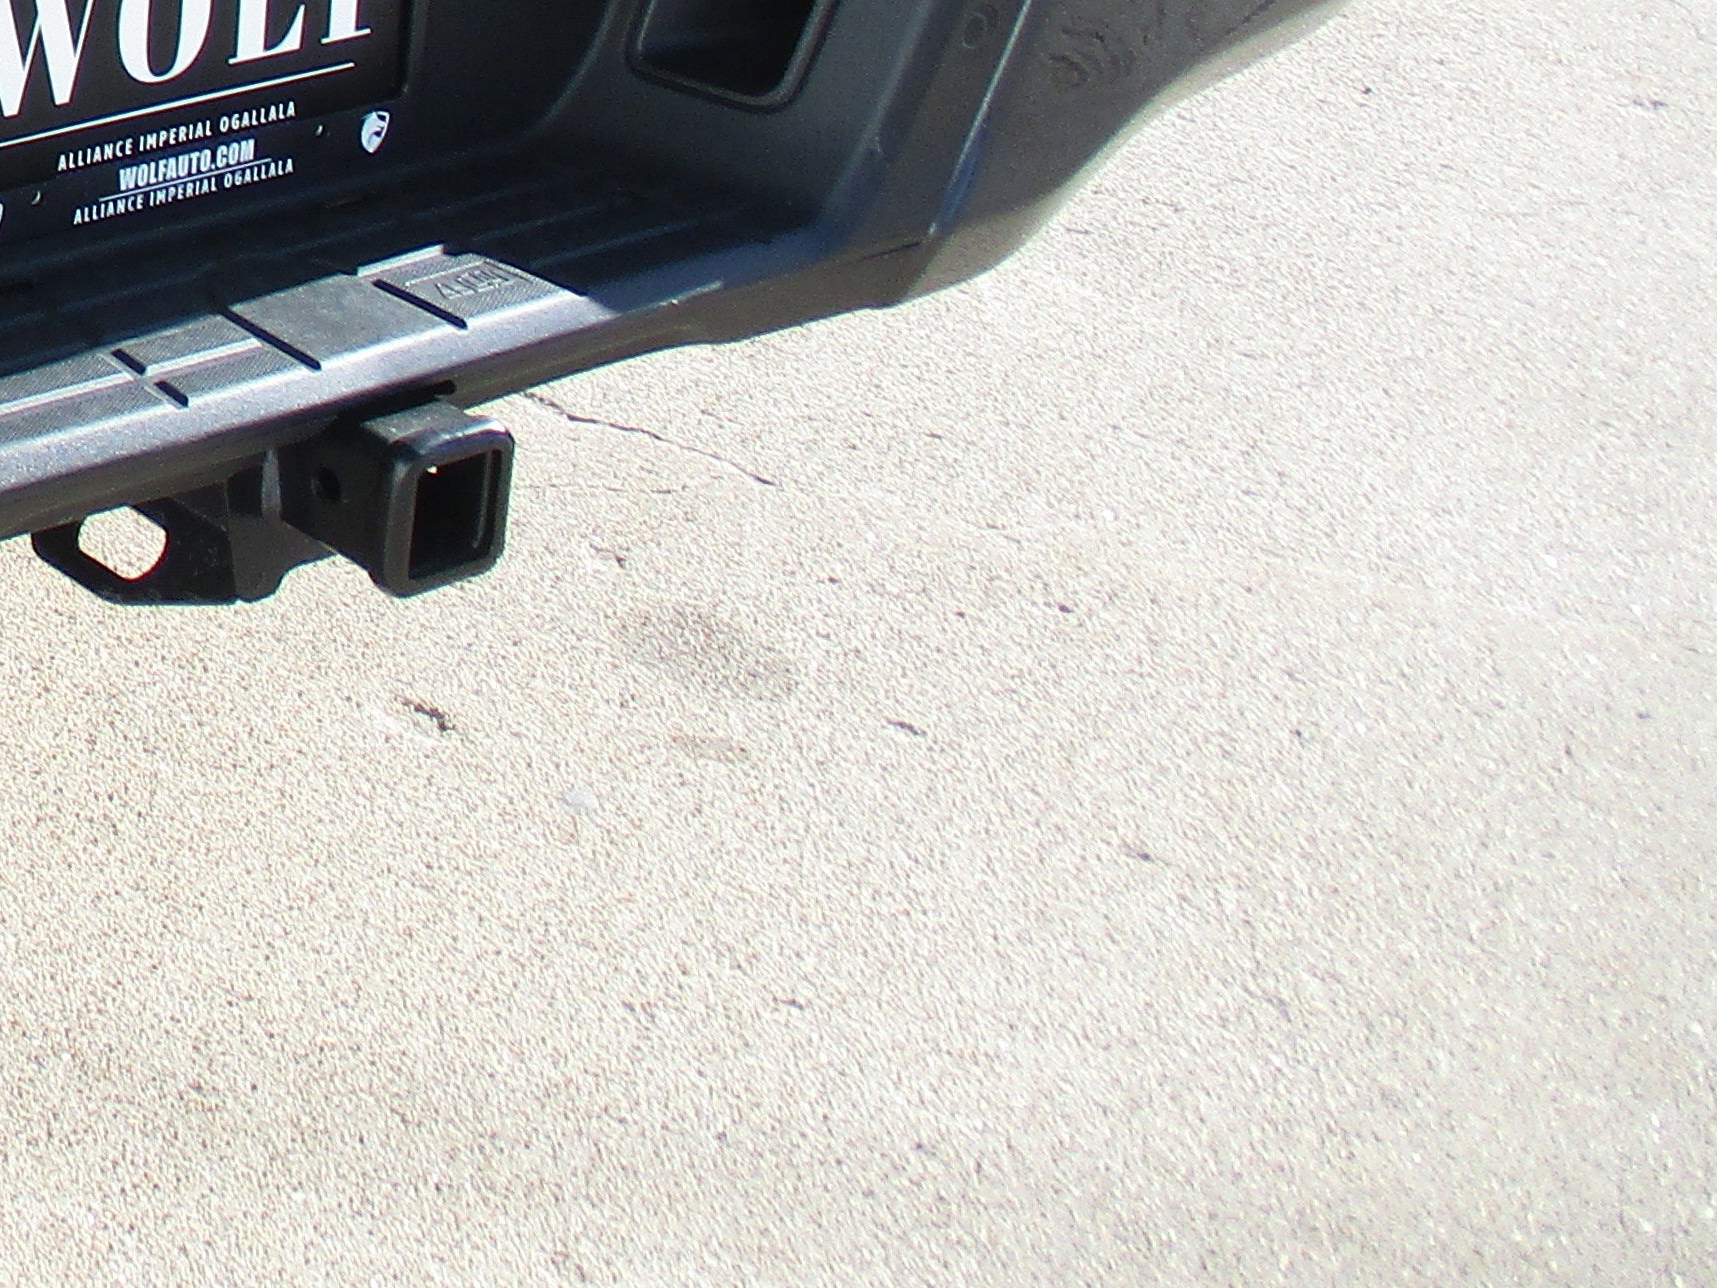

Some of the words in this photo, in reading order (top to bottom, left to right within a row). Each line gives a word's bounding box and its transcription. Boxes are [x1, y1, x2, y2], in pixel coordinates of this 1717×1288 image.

[57, 138, 133, 172] ALLIANCE
[139, 120, 213, 152] IMPERIAL
[219, 101, 296, 133] OGALLALA
[118, 138, 256, 192] WOLFAUTO.COM
[73, 196, 144, 225] ALLIANCE
[149, 177, 217, 207] IMPERIAL
[223, 158, 294, 188] OGALLALA
